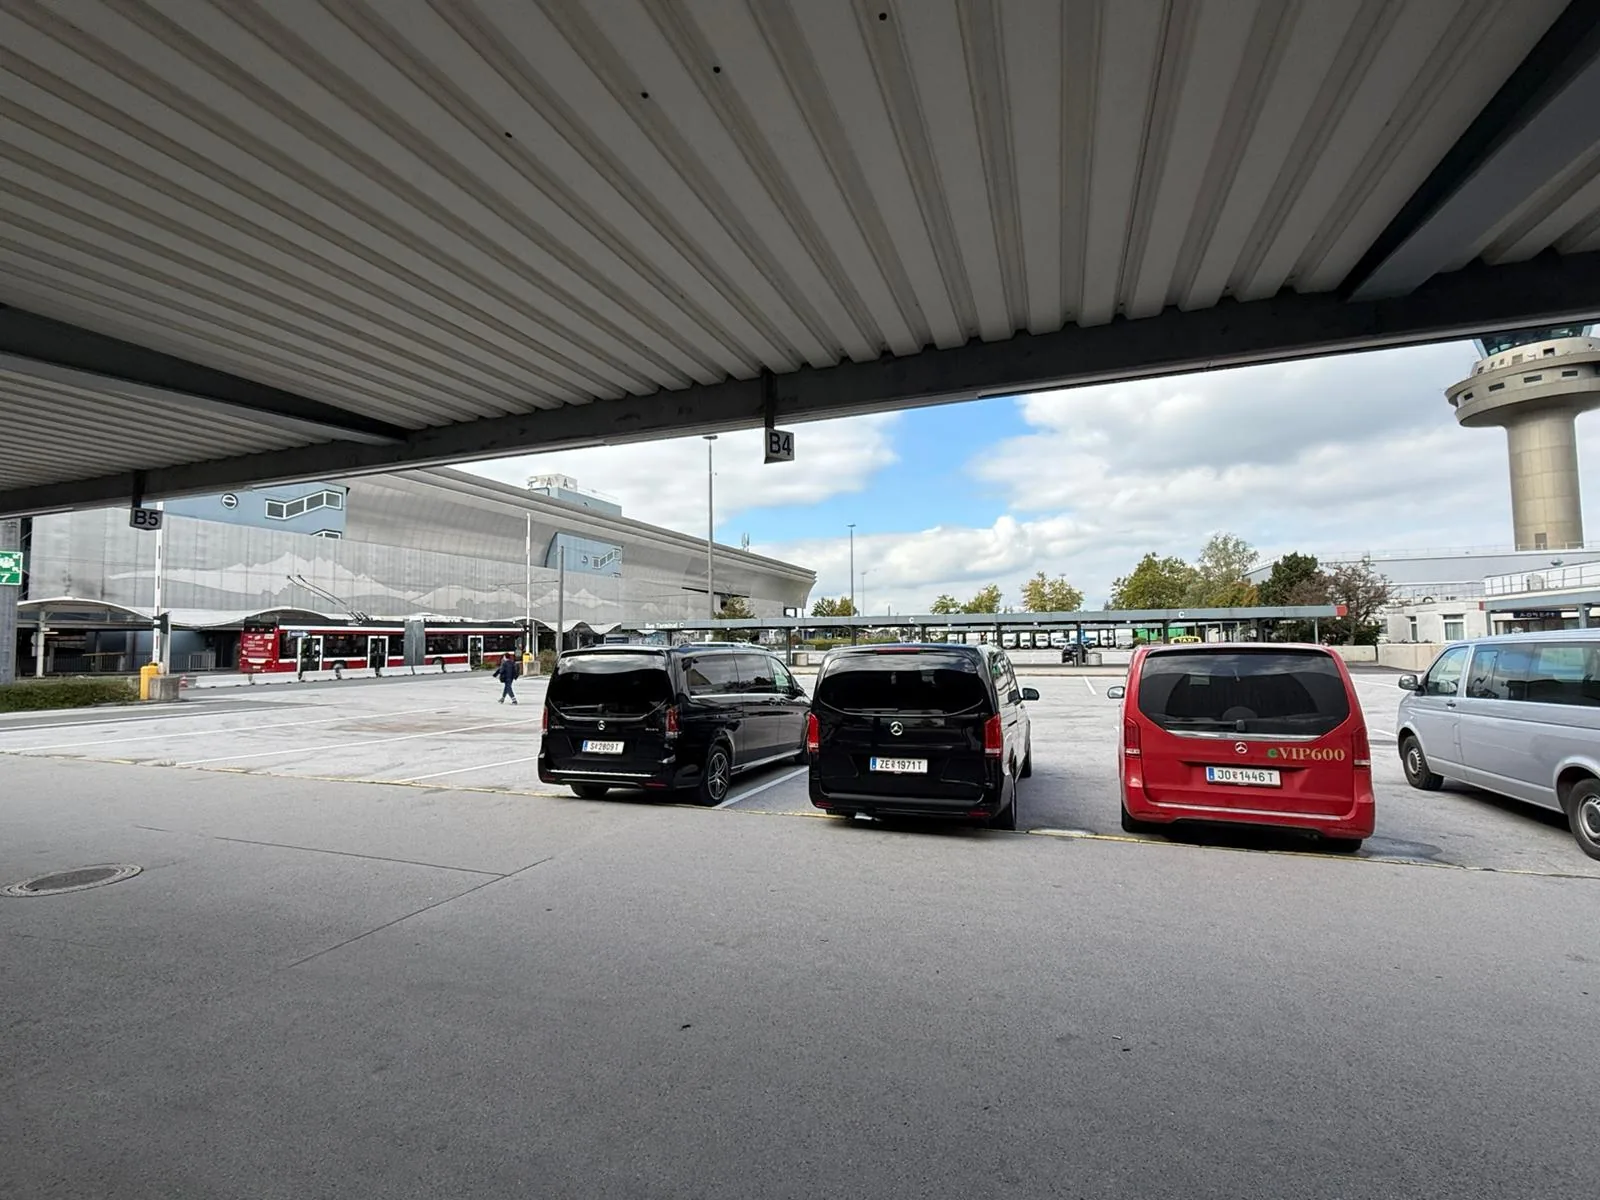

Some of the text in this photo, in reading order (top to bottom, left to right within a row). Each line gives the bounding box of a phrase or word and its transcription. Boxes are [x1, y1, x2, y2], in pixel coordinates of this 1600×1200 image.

[769, 432, 792, 456] B4
[134, 511, 158, 526] B5
[0, 574, 10, 583] 7
